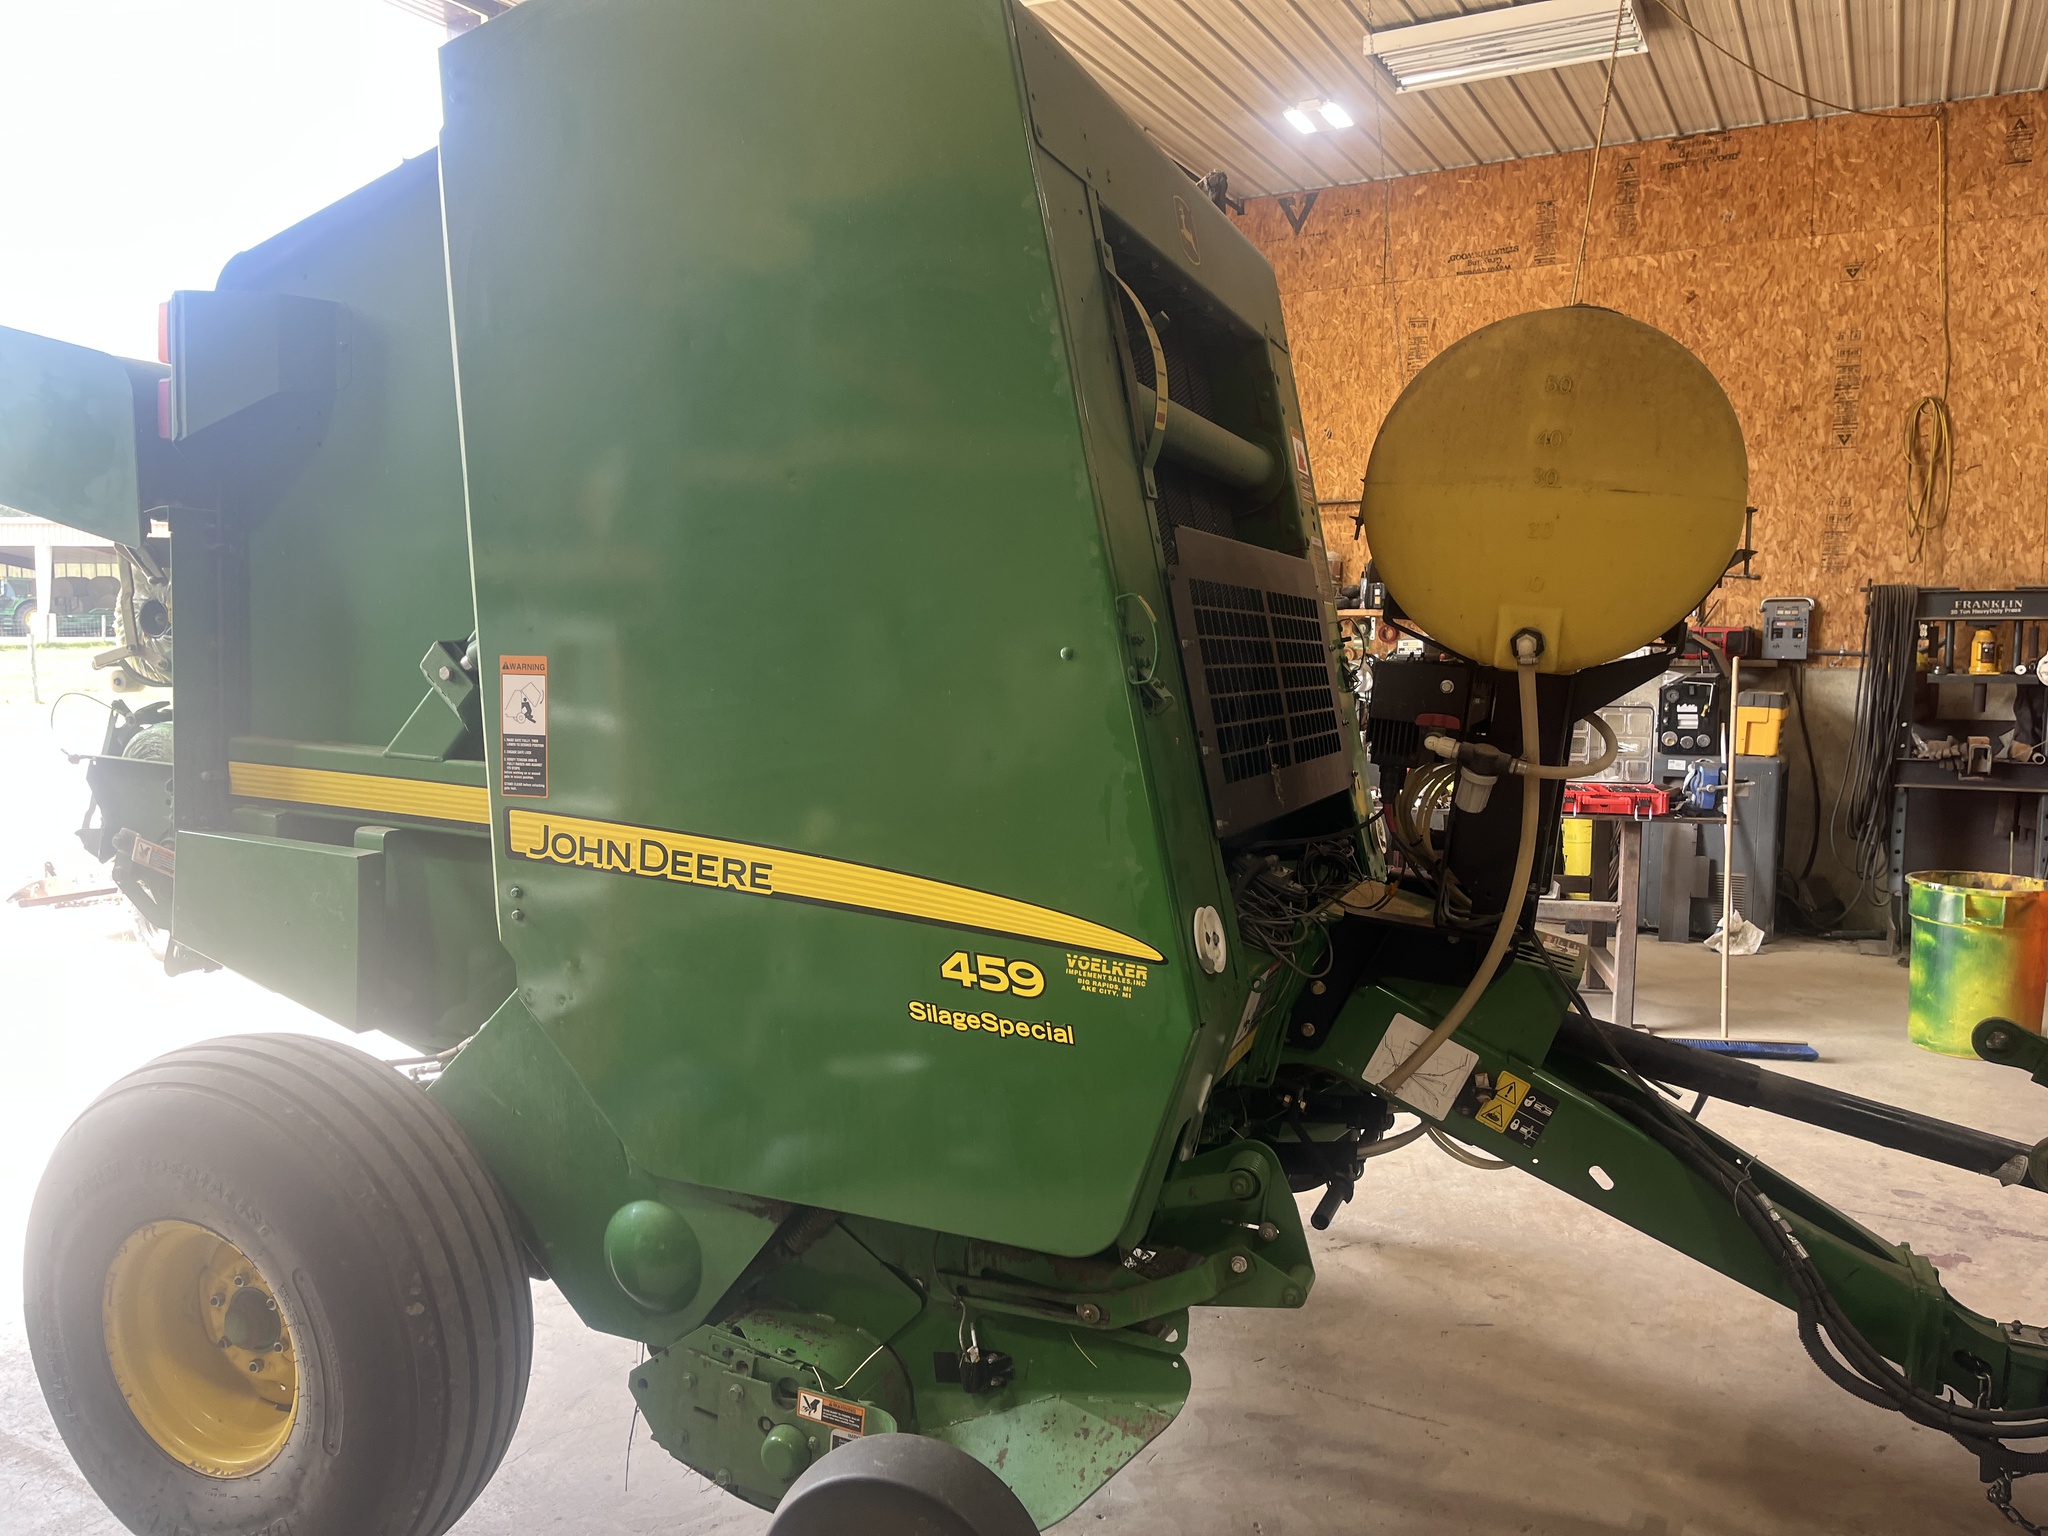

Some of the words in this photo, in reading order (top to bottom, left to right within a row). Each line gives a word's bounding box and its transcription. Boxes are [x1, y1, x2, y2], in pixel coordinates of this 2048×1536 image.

[1544, 375, 1573, 393] 50
[1536, 429, 1563, 447] 40
[1532, 466, 1559, 486] 30
[1527, 521, 1554, 539] 20
[1955, 600, 2023, 608] FRANKLIN
[509, 662, 545, 671] WARNING
[529, 824, 631, 869] JOHN
[639, 838, 773, 891] DEERE
[941, 951, 1045, 998] 459
[1066, 953, 1148, 980] VOELKER
[1066, 968, 1107, 981] IMPLEMENT
[908, 1001, 1074, 1044] SilageSpecial
